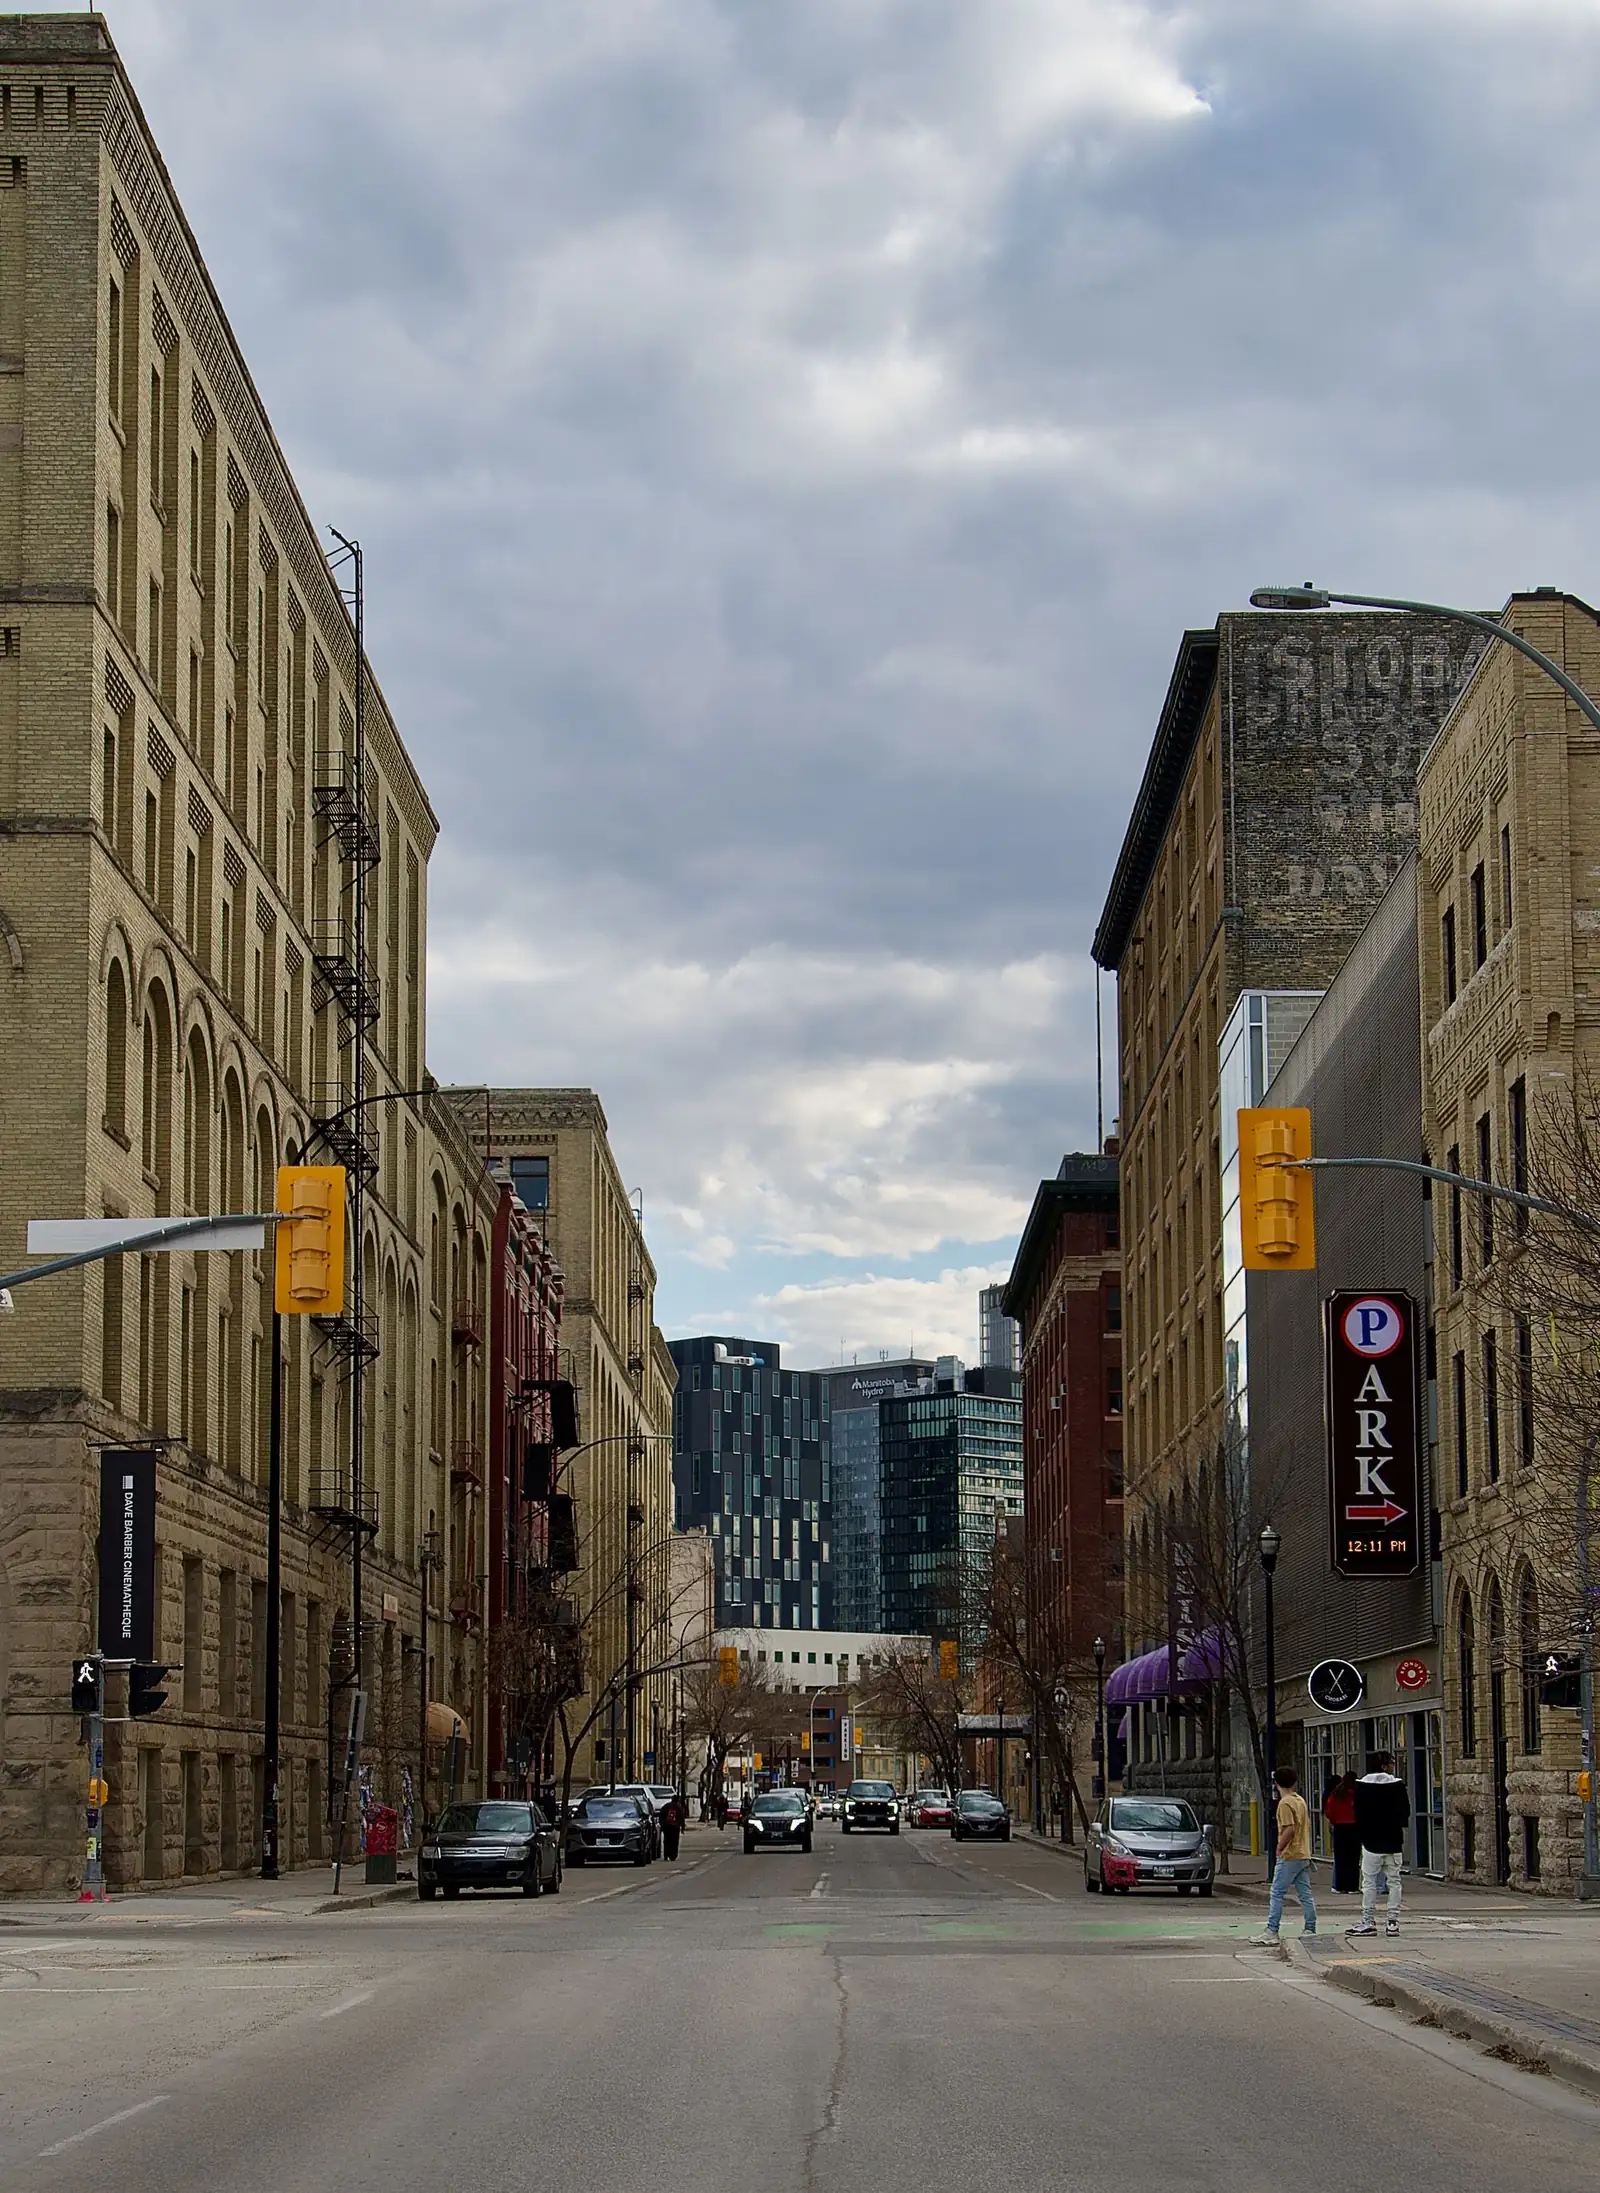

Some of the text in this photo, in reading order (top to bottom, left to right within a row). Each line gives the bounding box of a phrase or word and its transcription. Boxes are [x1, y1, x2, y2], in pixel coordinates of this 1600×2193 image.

[862, 1378, 895, 1388] Manitoba
[862, 1388, 884, 1399] Hydro
[1354, 1308, 1395, 1495] PARK
[1348, 1540, 1406, 1552] 12:11 PM
[121, 1492, 133, 1638] DAVE BARBER CINEMATHEQUE
